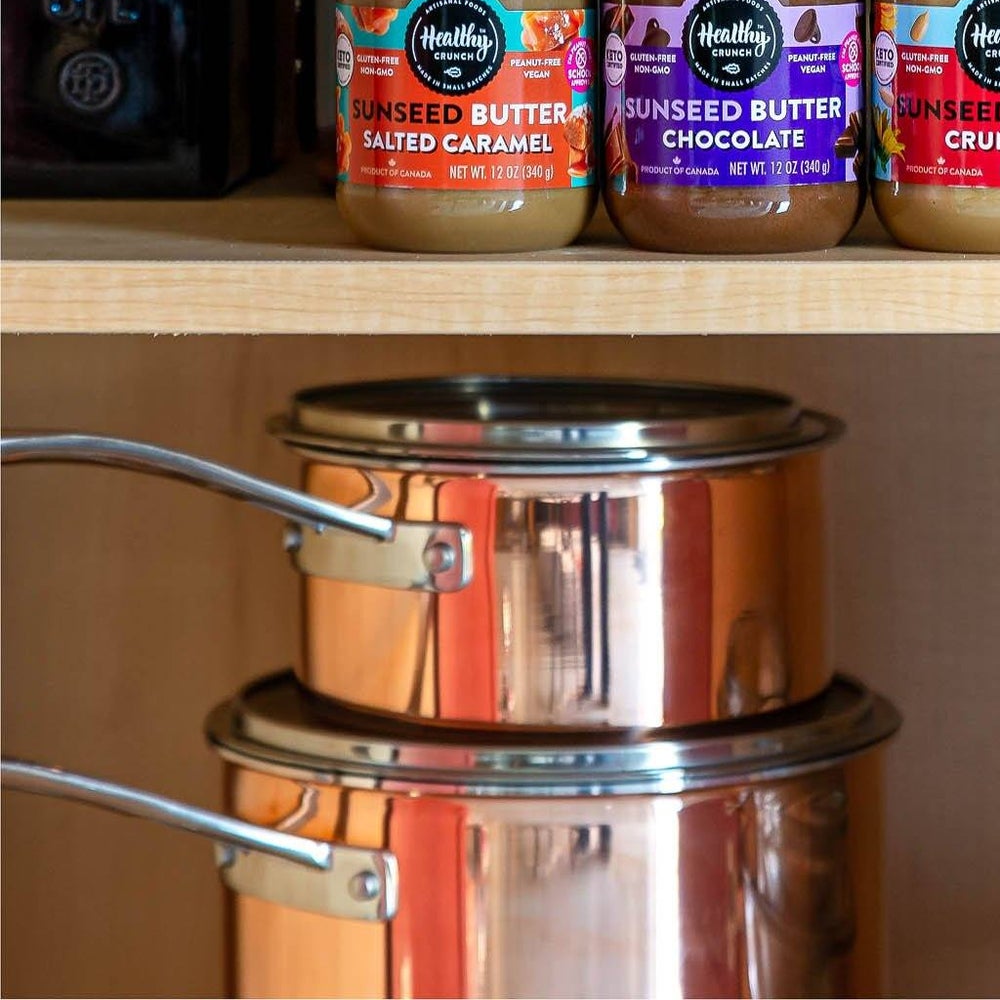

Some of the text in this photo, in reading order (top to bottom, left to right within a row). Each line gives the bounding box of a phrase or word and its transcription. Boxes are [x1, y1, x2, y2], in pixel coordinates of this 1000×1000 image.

[425, 0, 487, 16] ARTISANAL FOODS
[420, 23, 492, 62] Healthy
[698, 19, 770, 57] Healthy
[434, 53, 474, 61] CRUNCH
[630, 53, 676, 63] GLUTEN-FREE
[712, 49, 751, 57] CRUNCH
[788, 53, 835, 62] PEANUT-FREE
[876, 49, 894, 61] KETO
[901, 53, 949, 63] GLUTEN-FREE
[357, 54, 399, 65] GLUTEN-FREE
[511, 59, 561, 67] PEANUT-FREE
[361, 68, 393, 76] NON-GMO
[634, 65, 670, 75] NON-GMO
[695, 62, 710, 79] MADE
[721, 79, 743, 87] SMALL
[746, 62, 771, 84] BATCHES
[800, 65, 826, 73] VEGAN
[906, 65, 943, 75] NON-GMO
[968, 63, 983, 80] MADE
[417, 65, 434, 82] MADE
[435, 79, 441, 87] IN
[467, 65, 493, 89] BATCHES
[353, 99, 567, 125] SUNSEED BUTTER
[626, 97, 841, 122] SUNSEED BUTTER
[363, 130, 553, 154] SALTED CARAMEL
[662, 129, 805, 149] CHOCOLATE
[450, 165, 553, 180] NET WT. 12 OZ (340 g)
[641, 165, 719, 176] PRODUCT OF CANADA
[730, 159, 829, 175] NET WT. 12 OZ (340 g)
[906, 165, 983, 176] PRODUCT OF CANADA
